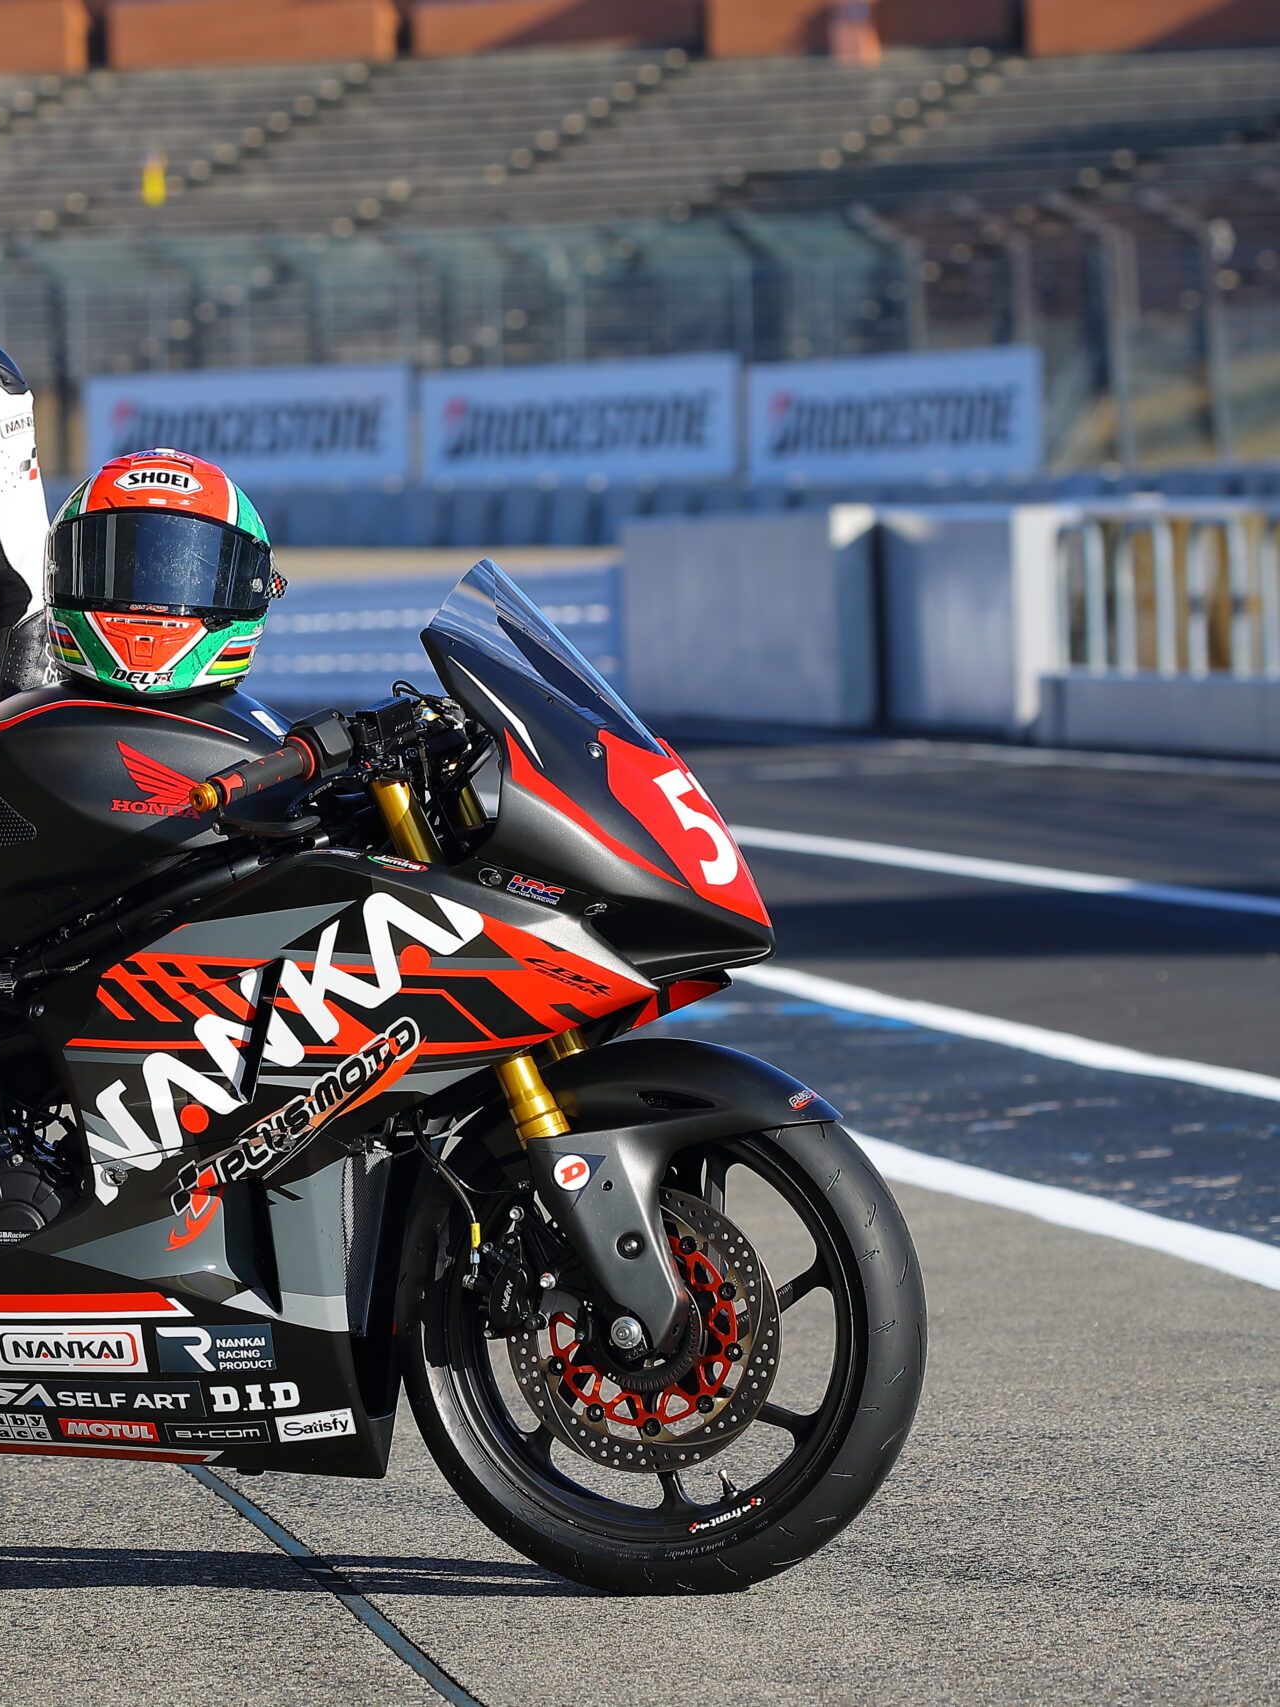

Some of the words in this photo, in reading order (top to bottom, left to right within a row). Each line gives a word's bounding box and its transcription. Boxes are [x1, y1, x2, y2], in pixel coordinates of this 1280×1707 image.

[128, 471, 190, 489] SHOEI
[111, 799, 202, 821] HONDA
[507, 875, 566, 902] HRC
[85, 892, 485, 1206] NANKAI
[216, 1094, 317, 1184] PLUS
[311, 1016, 421, 1115] MOTO
[11, 1340, 125, 1360] NANKAI
[216, 1336, 266, 1349] NANKAI
[217, 1349, 261, 1360] RACING
[219, 1359, 273, 1371] PRODUCT
[56, 1391, 127, 1408] SELF
[132, 1393, 191, 1410] ART
[209, 1381, 301, 1413] D.I.D
[67, 1422, 154, 1440] MOTUL
[283, 1418, 350, 1437] Satisfy
[709, 1509, 743, 1528] front
